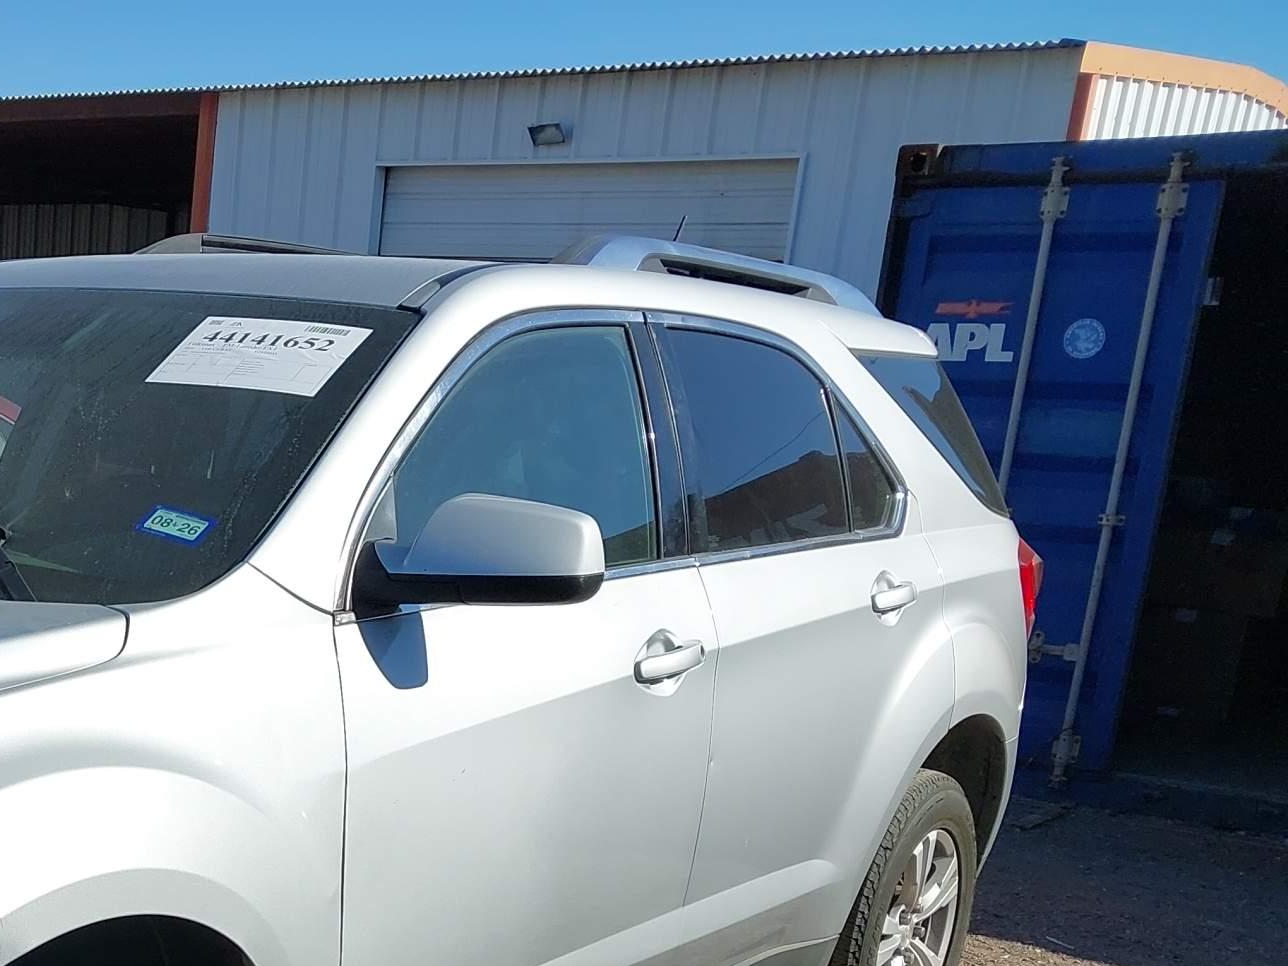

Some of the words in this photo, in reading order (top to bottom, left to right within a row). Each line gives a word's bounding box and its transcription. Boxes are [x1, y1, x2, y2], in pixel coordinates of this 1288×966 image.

[202, 330, 335, 352] 44141652
[926, 323, 1013, 362] APL
[151, 515, 174, 528] 08
[176, 522, 201, 536] 26
